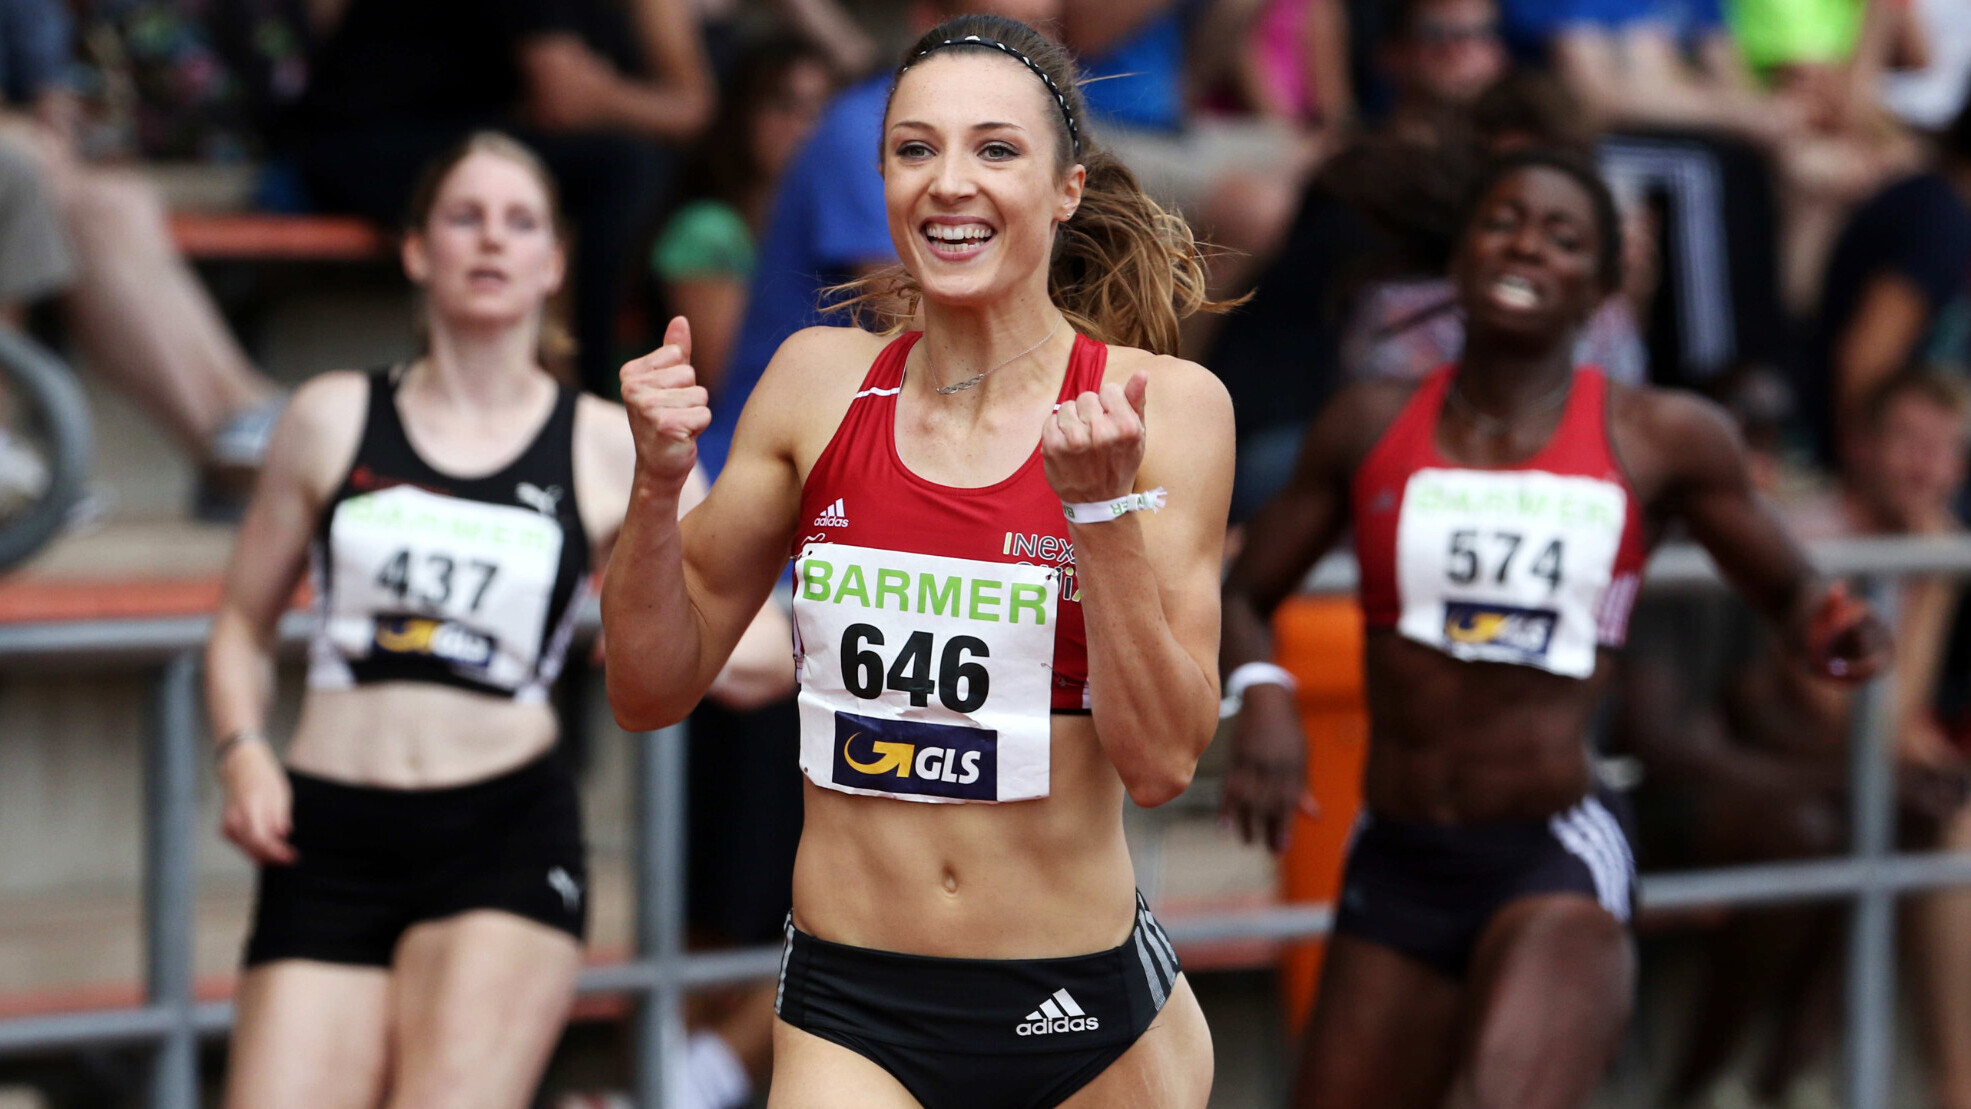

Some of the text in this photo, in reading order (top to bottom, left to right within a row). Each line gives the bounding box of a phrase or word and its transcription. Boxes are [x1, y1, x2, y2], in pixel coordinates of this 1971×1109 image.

[814, 515, 850, 528] adidas
[377, 549, 498, 612] 437
[803, 559, 1048, 625] BARMER
[1447, 528, 1565, 593] 574
[840, 623, 990, 714] 646
[915, 746, 981, 785] GLS
[1016, 1016, 1099, 1036] adidas
